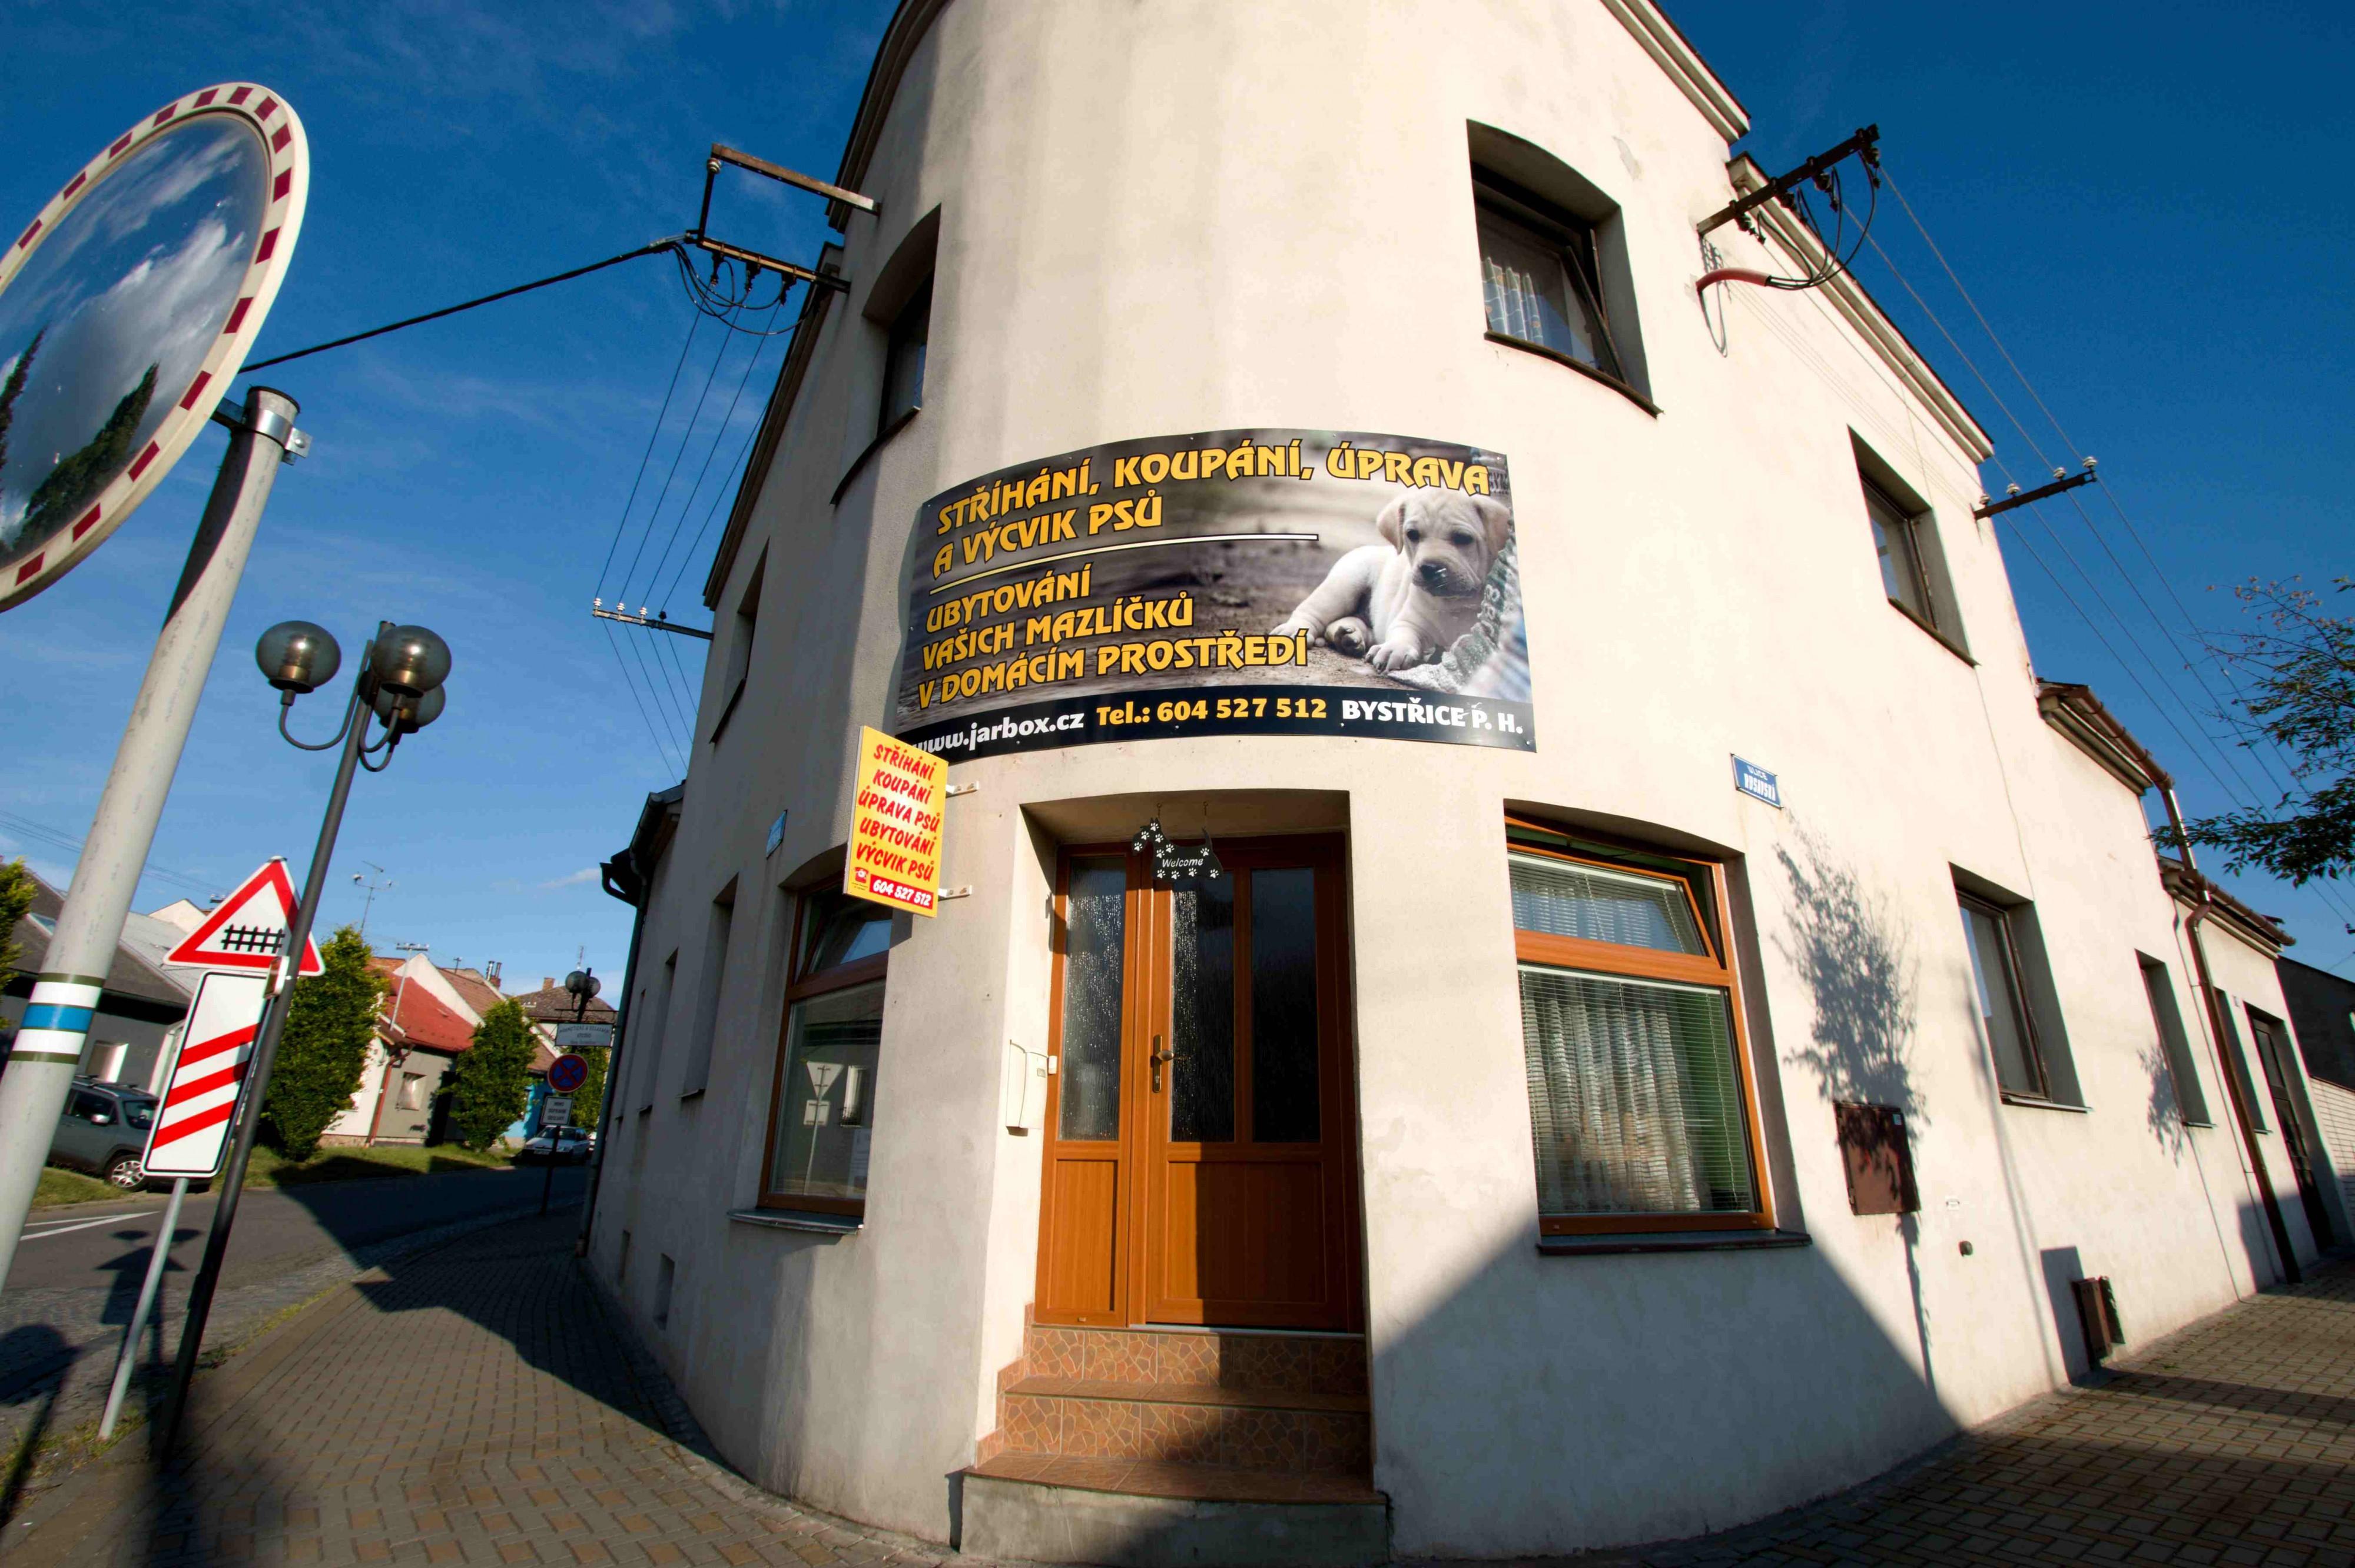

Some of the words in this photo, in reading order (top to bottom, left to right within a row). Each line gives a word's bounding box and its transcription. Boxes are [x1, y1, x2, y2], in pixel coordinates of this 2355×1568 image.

[937, 458, 1100, 536] STŘÍHÁNÍ,
[1113, 438, 1314, 489] KOUPÁNÍ,
[1326, 441, 1491, 496] ÚPRAVA
[933, 541, 954, 580] A
[962, 509, 1080, 564] VÝCVIK
[1089, 489, 1164, 536] PSŮ
[926, 562, 1093, 633] UBYTOVÁNÍ
[922, 620, 1015, 672] VAŠICH
[1026, 590, 1195, 645] MAZLÍČKŮ
[918, 680, 936, 710] V
[940, 646, 1086, 705] DOMÁCÍM
[1097, 628, 1310, 676] PROSTŘEDÍ
[1096, 702, 1150, 726] Tel.:
[1157, 700, 1208, 722] 604
[1216, 698, 1267, 719] 527
[1276, 698, 1326, 718] 512
[1342, 697, 1465, 727] BYSTŘICE
[1471, 709, 1492, 730] P.
[1498, 712, 1523, 734] H.
[874, 743, 937, 780] STŘÍHÁNÍ
[873, 769, 934, 804] KOUPÁNÍ
[858, 785, 912, 824] ÚPRAVA
[914, 812, 941, 833] PSŮ
[860, 816, 937, 856] UBYTOVÁNÍ
[856, 841, 908, 873] VÝCVIK
[907, 860, 935, 882] PSŮ
[1162, 858, 1203, 868] Welcome
[873, 879, 894, 895] 604
[894, 885, 914, 901] 527
[914, 891, 932, 906] 512
